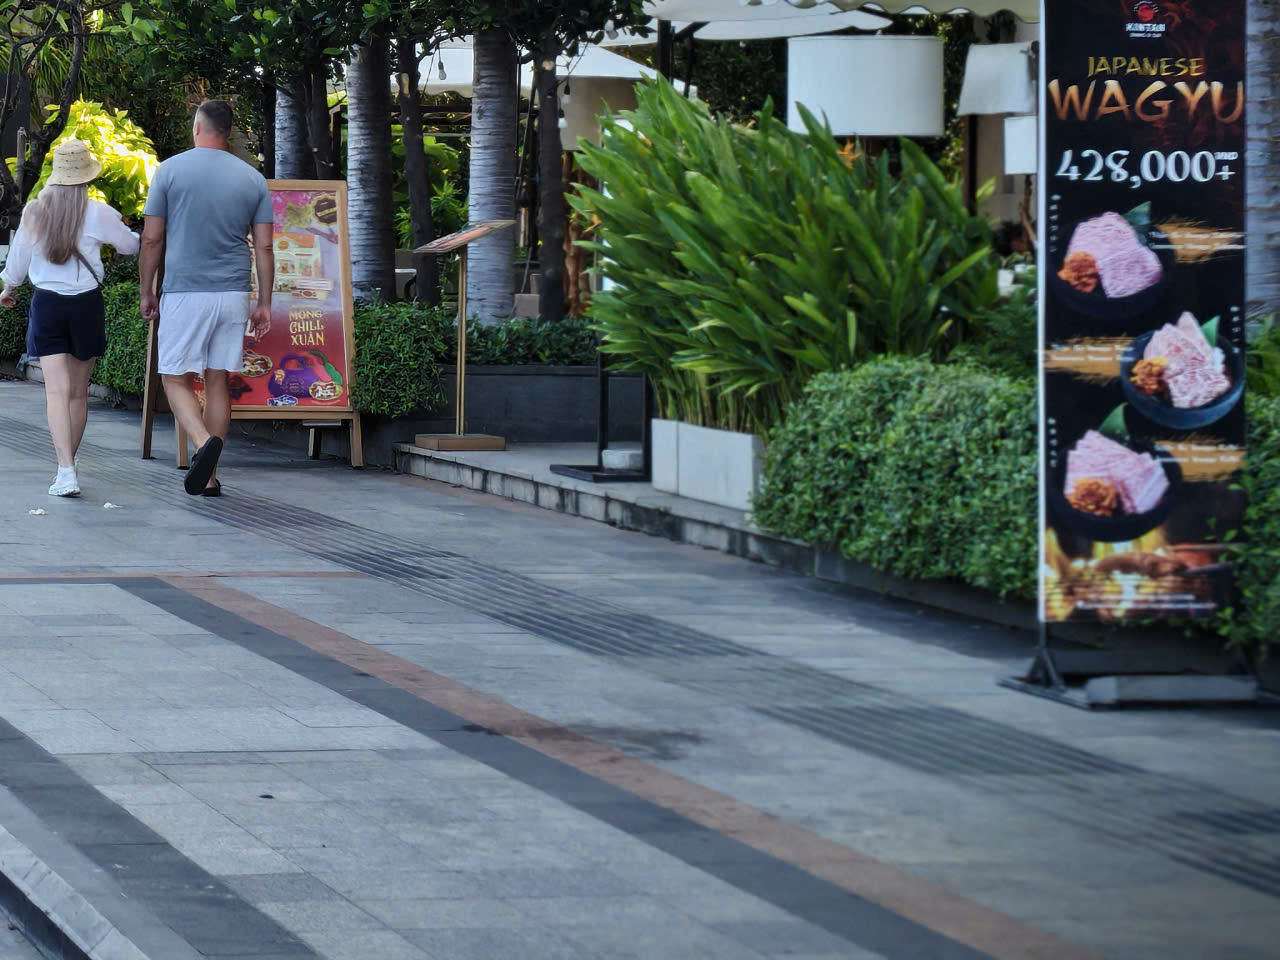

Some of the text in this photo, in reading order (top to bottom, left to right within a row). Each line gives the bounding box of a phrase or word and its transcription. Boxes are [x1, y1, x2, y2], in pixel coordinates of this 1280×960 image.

[1087, 56, 1206, 78] JAPANESE
[1048, 79, 1244, 123] WAGYU
[289, 319, 324, 334] CHILL
[290, 330, 325, 346] XUÂN
